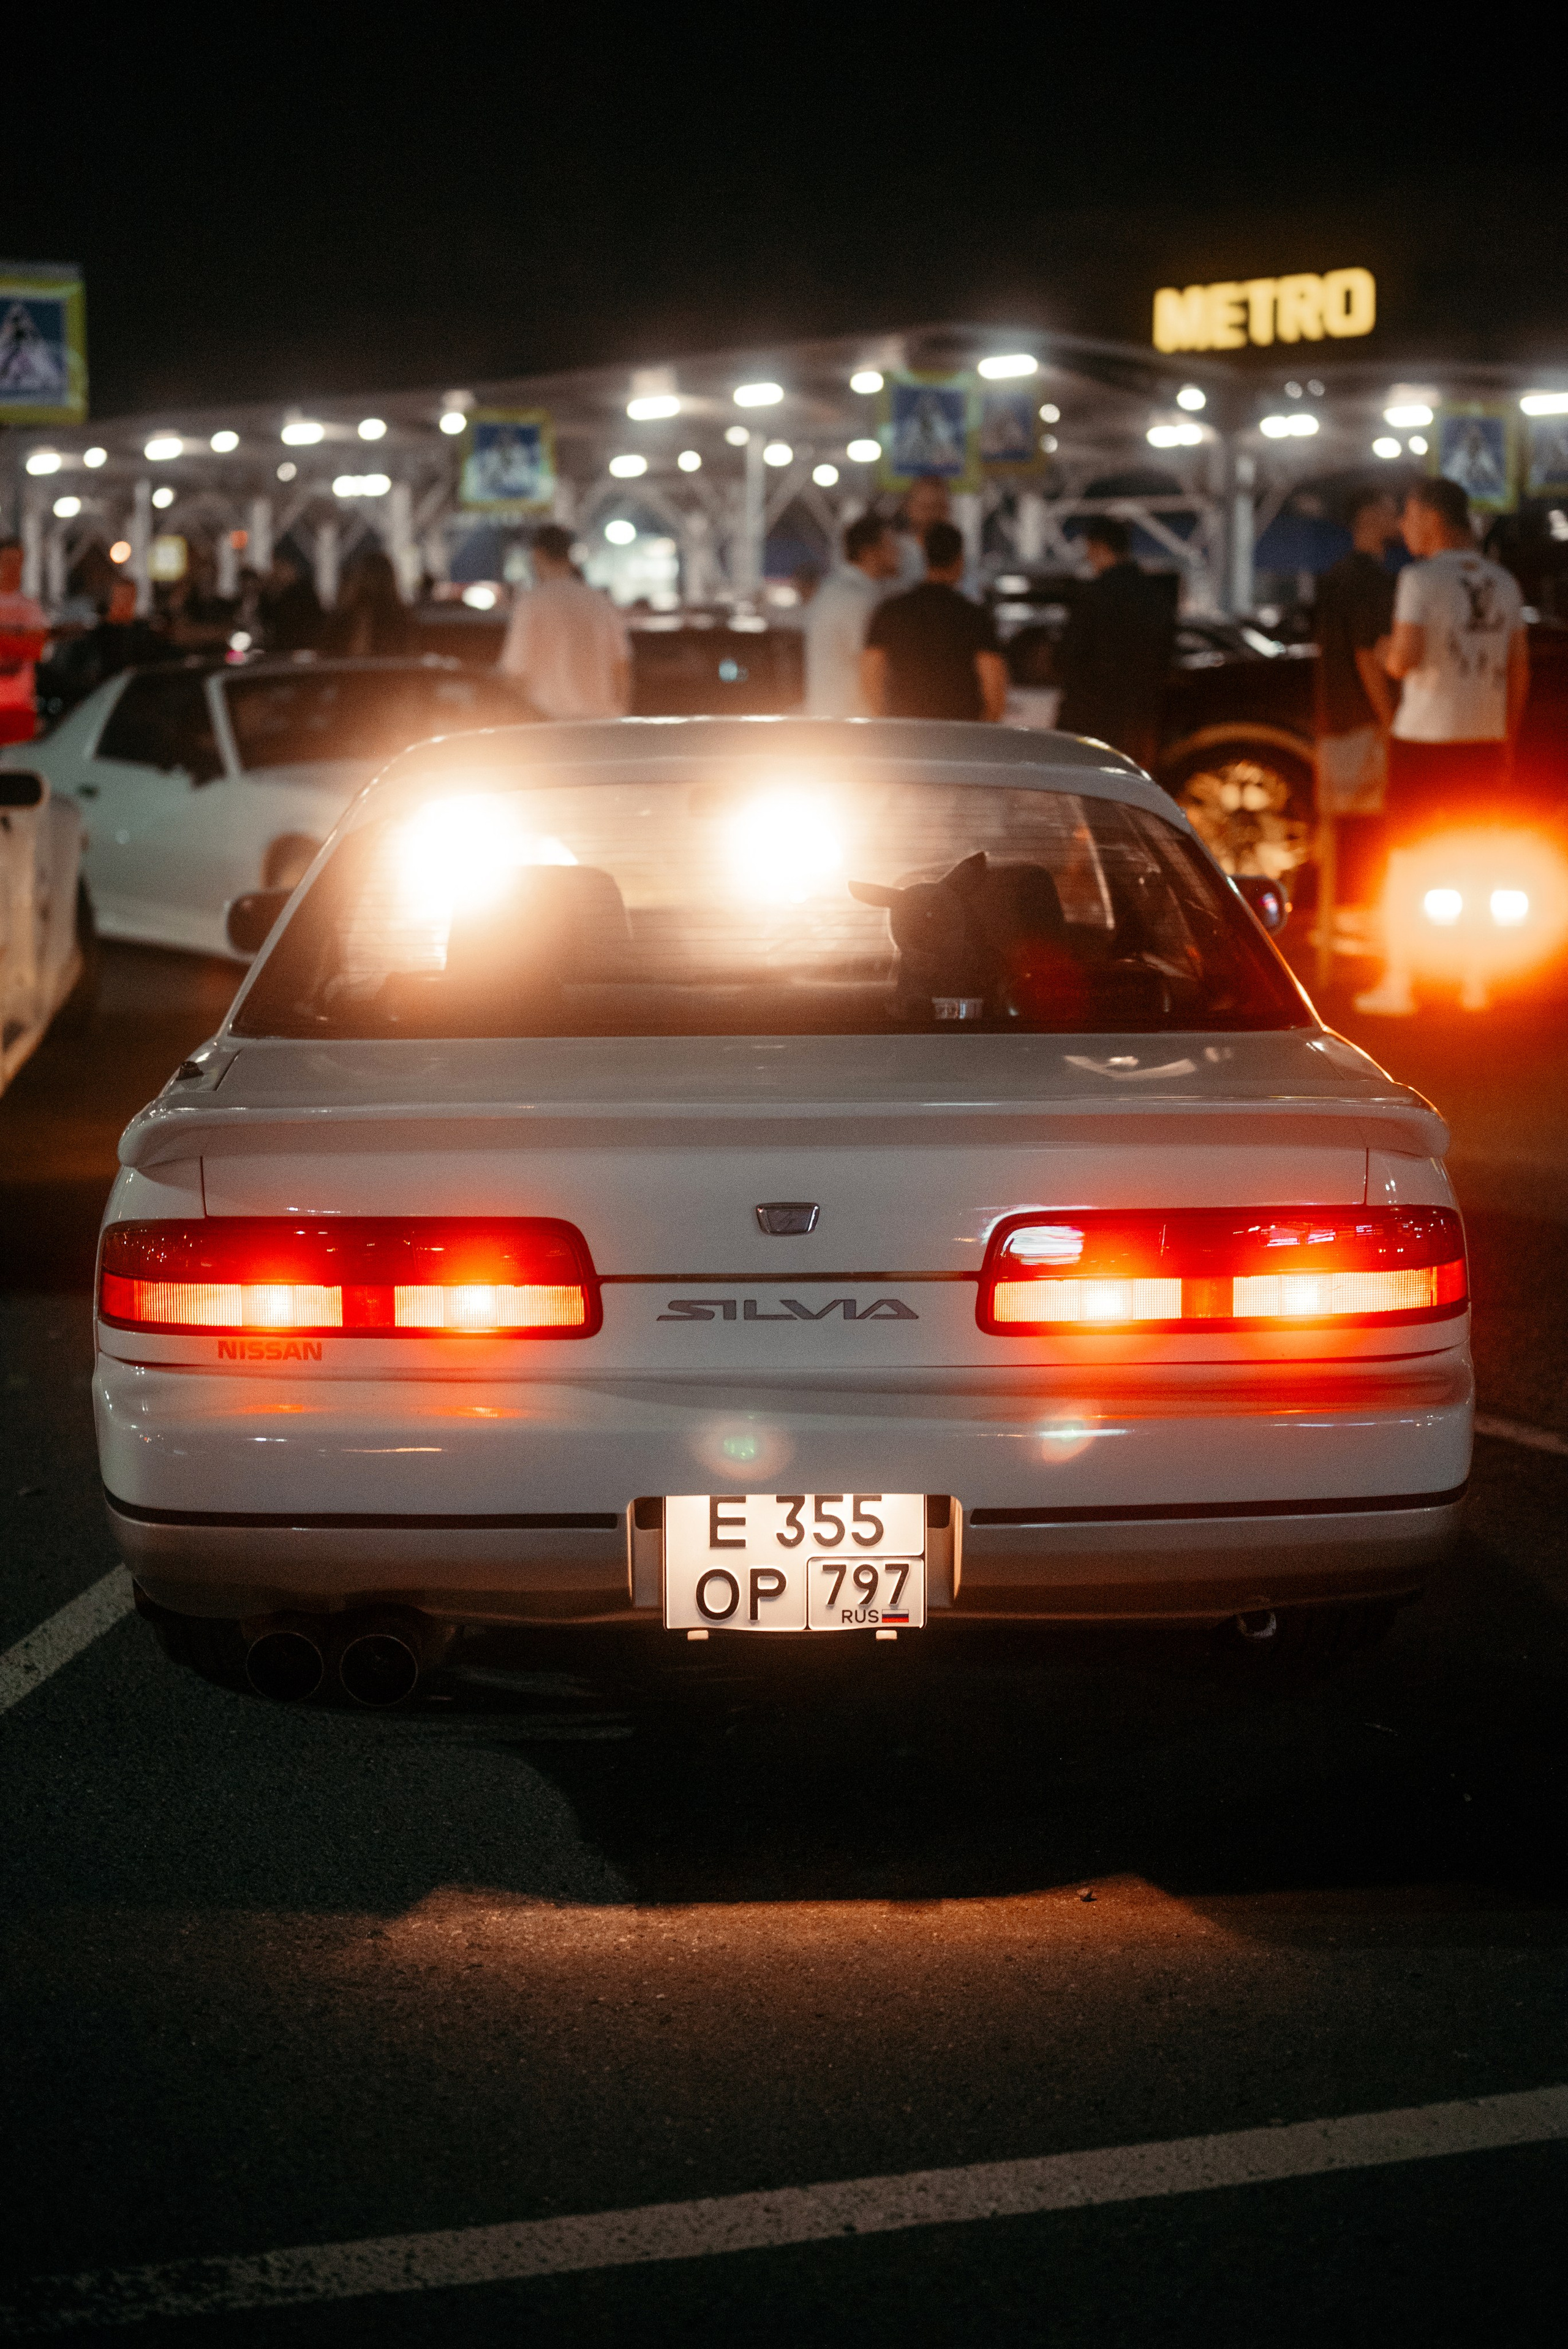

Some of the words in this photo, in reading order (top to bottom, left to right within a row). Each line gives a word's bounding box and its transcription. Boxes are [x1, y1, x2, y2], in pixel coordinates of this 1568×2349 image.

[1153, 267, 1376, 354] METRO
[657, 1299, 919, 1321] SILVIA
[217, 1341, 322, 1361] NISSAN
[709, 1495, 747, 1549] E
[775, 1494, 884, 1548] 355
[695, 1568, 787, 1621] OP
[822, 1563, 910, 1606] 797
[842, 1609, 879, 1624] RUS
